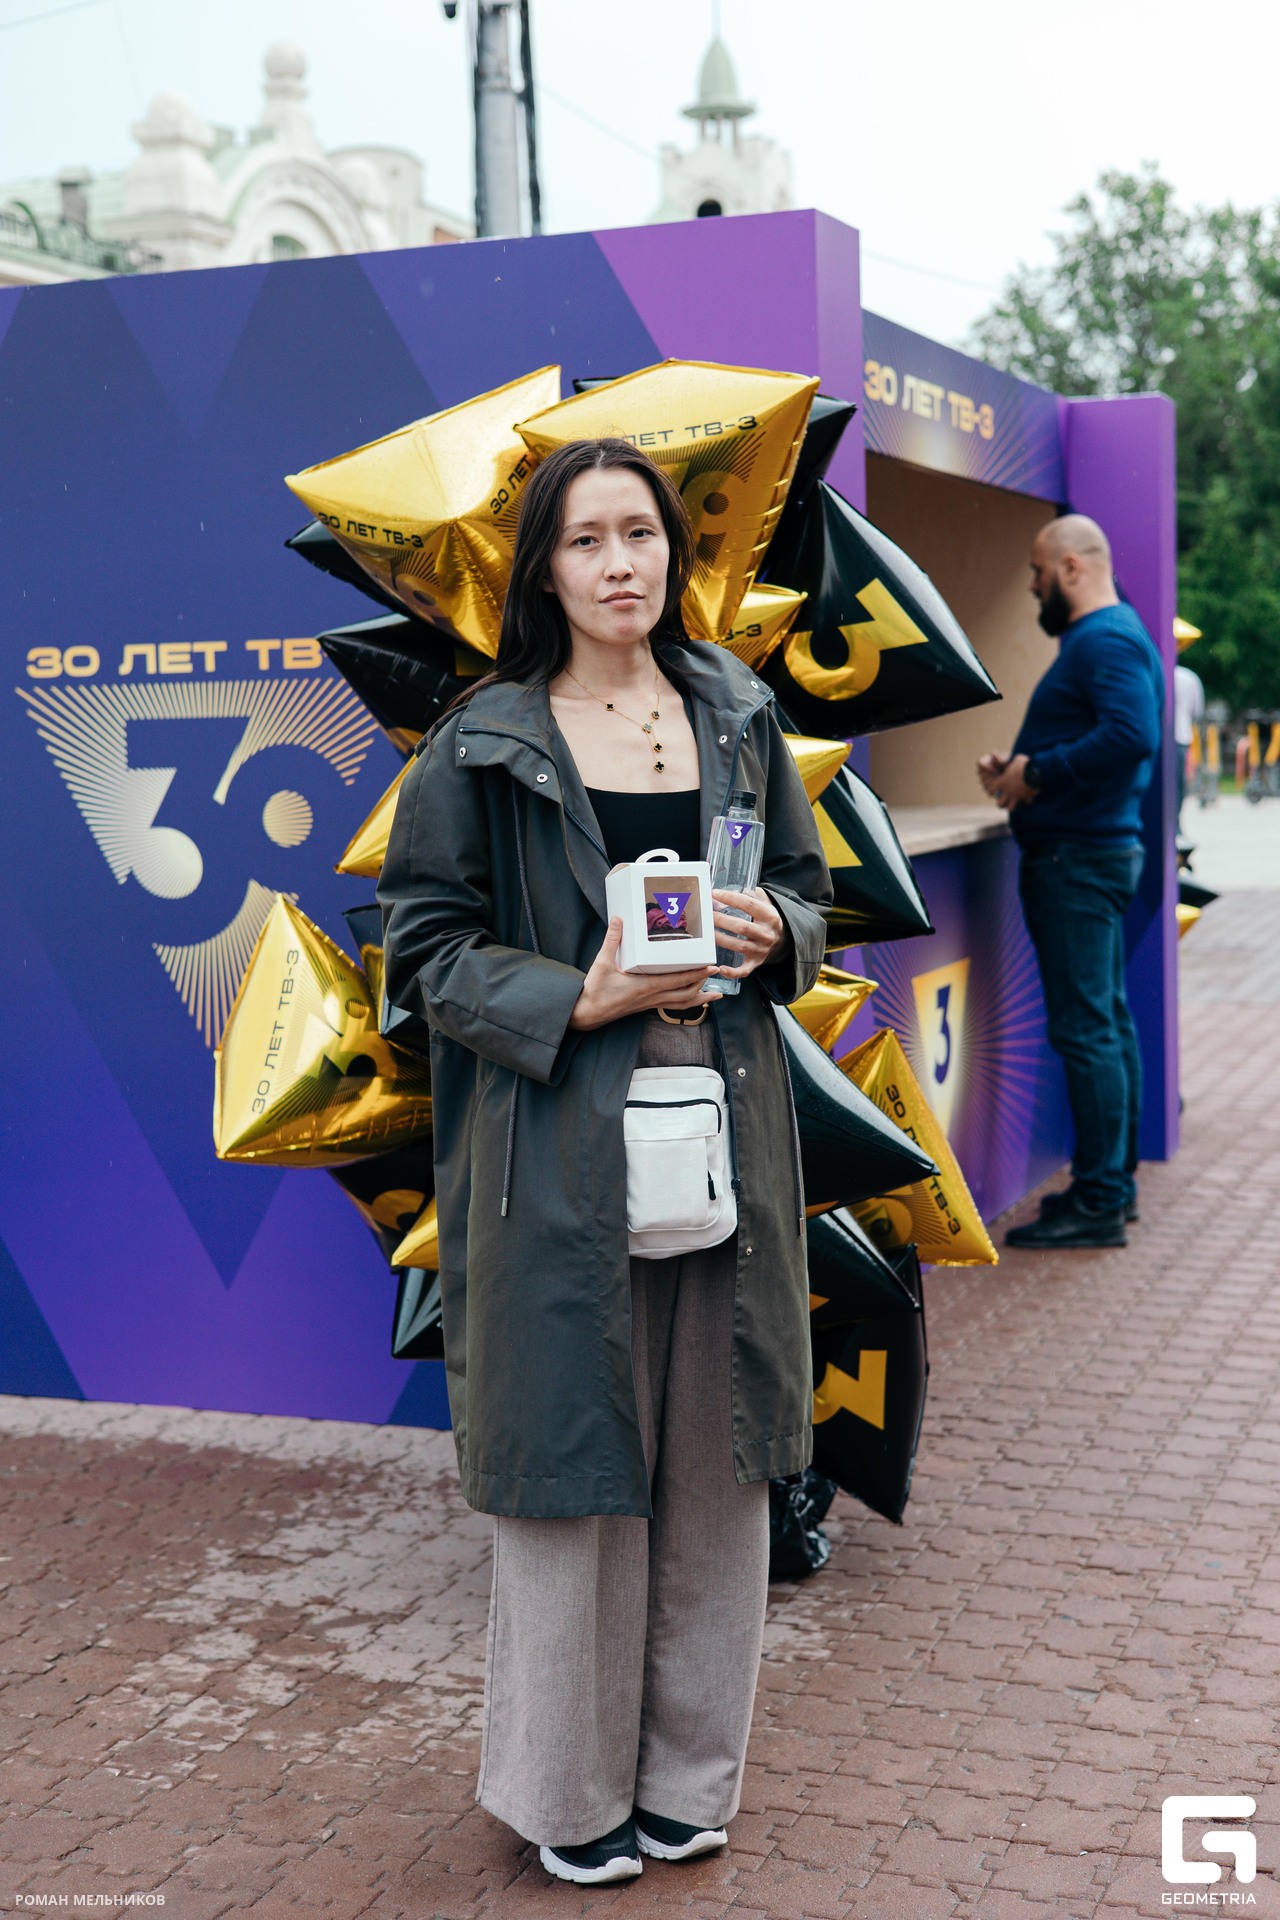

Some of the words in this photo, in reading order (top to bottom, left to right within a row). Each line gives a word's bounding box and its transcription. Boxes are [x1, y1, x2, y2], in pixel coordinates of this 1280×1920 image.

[864, 360, 898, 406] 30
[902, 374, 945, 422] ЛЕТ
[947, 390, 995, 440] ТВ-3
[684, 415, 758, 438] ТВ-3
[490, 488, 509, 515] 30
[508, 454, 532, 490] ЛЕТ
[318, 512, 341, 531] 30
[347, 520, 377, 539] ЛЕТ
[383, 529, 424, 548] ТВ-3
[26, 645, 100, 678] 30
[118, 641, 228, 676] ЛЕТ
[245, 638, 324, 670] ТВ
[731, 825, 743, 840] 3
[667, 897, 679, 915] 3
[252, 1079, 271, 1114] 30
[265, 1020, 285, 1069] ЛЕТ
[278, 949, 299, 1011] ТВ-3
[933, 984, 951, 1085] 3
[886, 1084, 906, 1118] 30
[930, 1176, 962, 1235] ТВ-3
